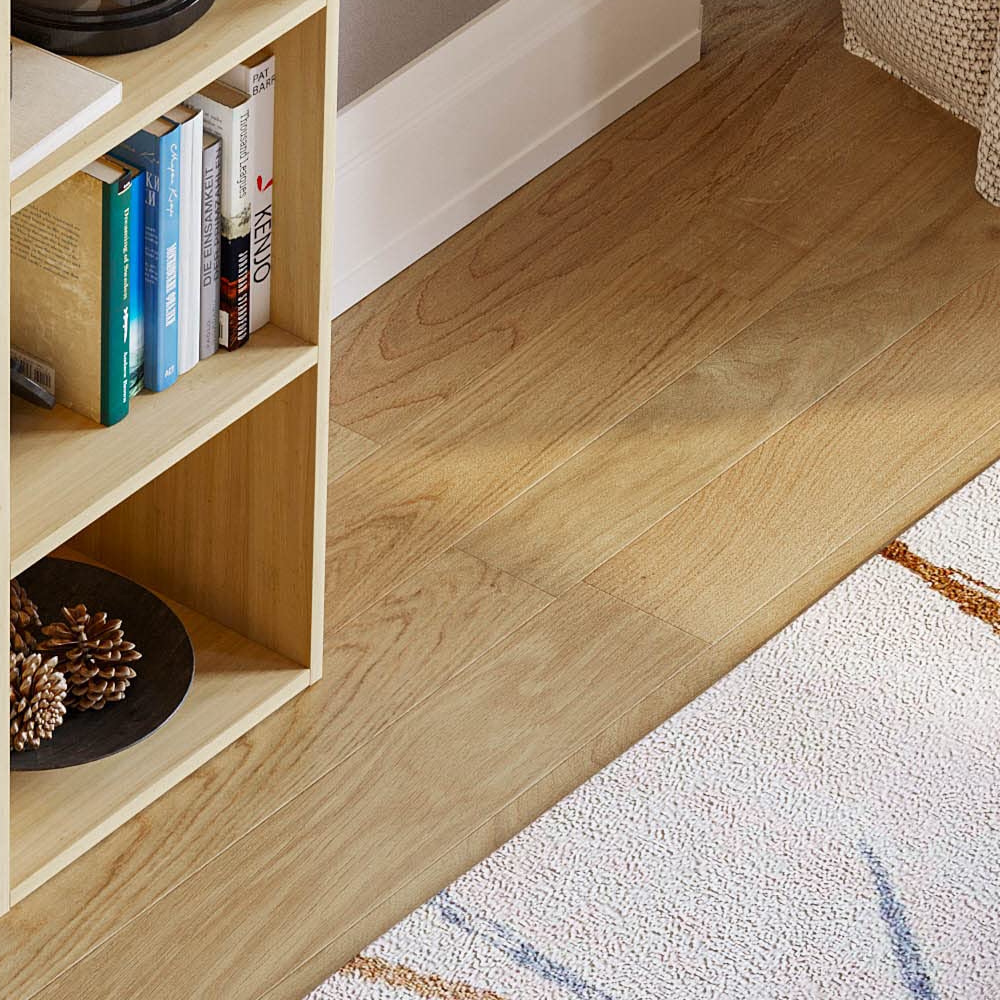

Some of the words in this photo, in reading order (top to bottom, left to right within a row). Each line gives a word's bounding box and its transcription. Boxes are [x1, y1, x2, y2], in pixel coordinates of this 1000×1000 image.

[253, 67, 269, 84] PAT
[204, 168, 213, 258] EINSAMKEIT
[203, 265, 212, 287] DIE
